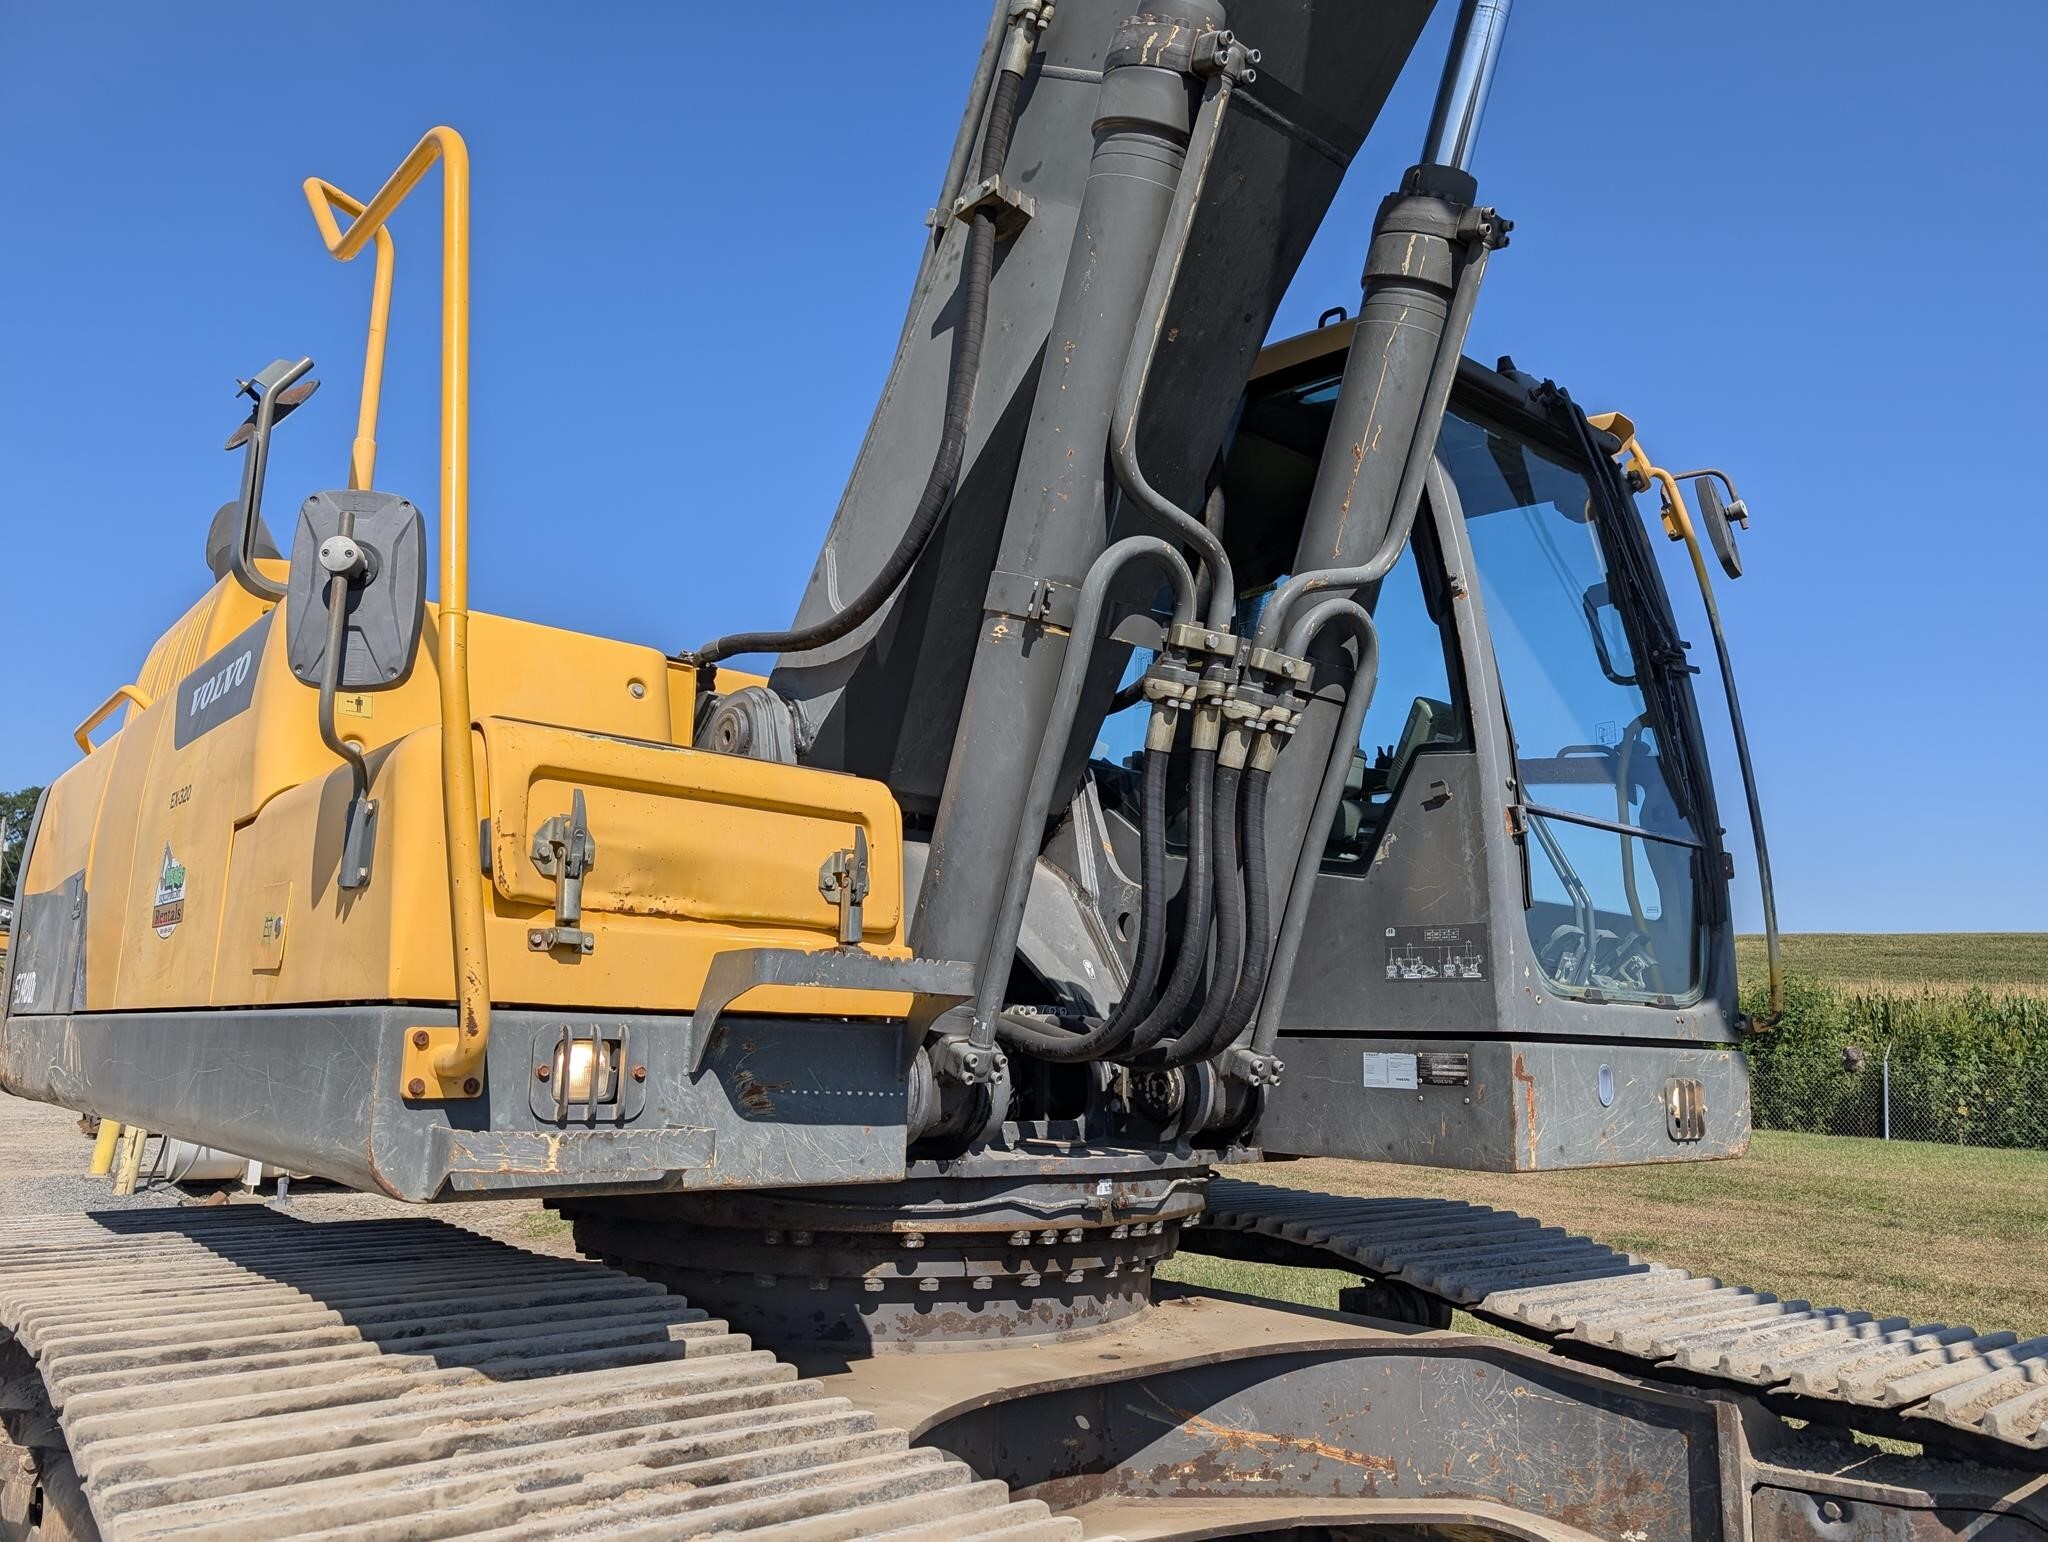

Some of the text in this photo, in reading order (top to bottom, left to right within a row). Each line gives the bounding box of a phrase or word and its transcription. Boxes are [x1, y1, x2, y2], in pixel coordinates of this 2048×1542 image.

[190, 650, 252, 717] VOLVO
[169, 784, 192, 809] EX-320
[154, 903, 182, 924] Rentals
